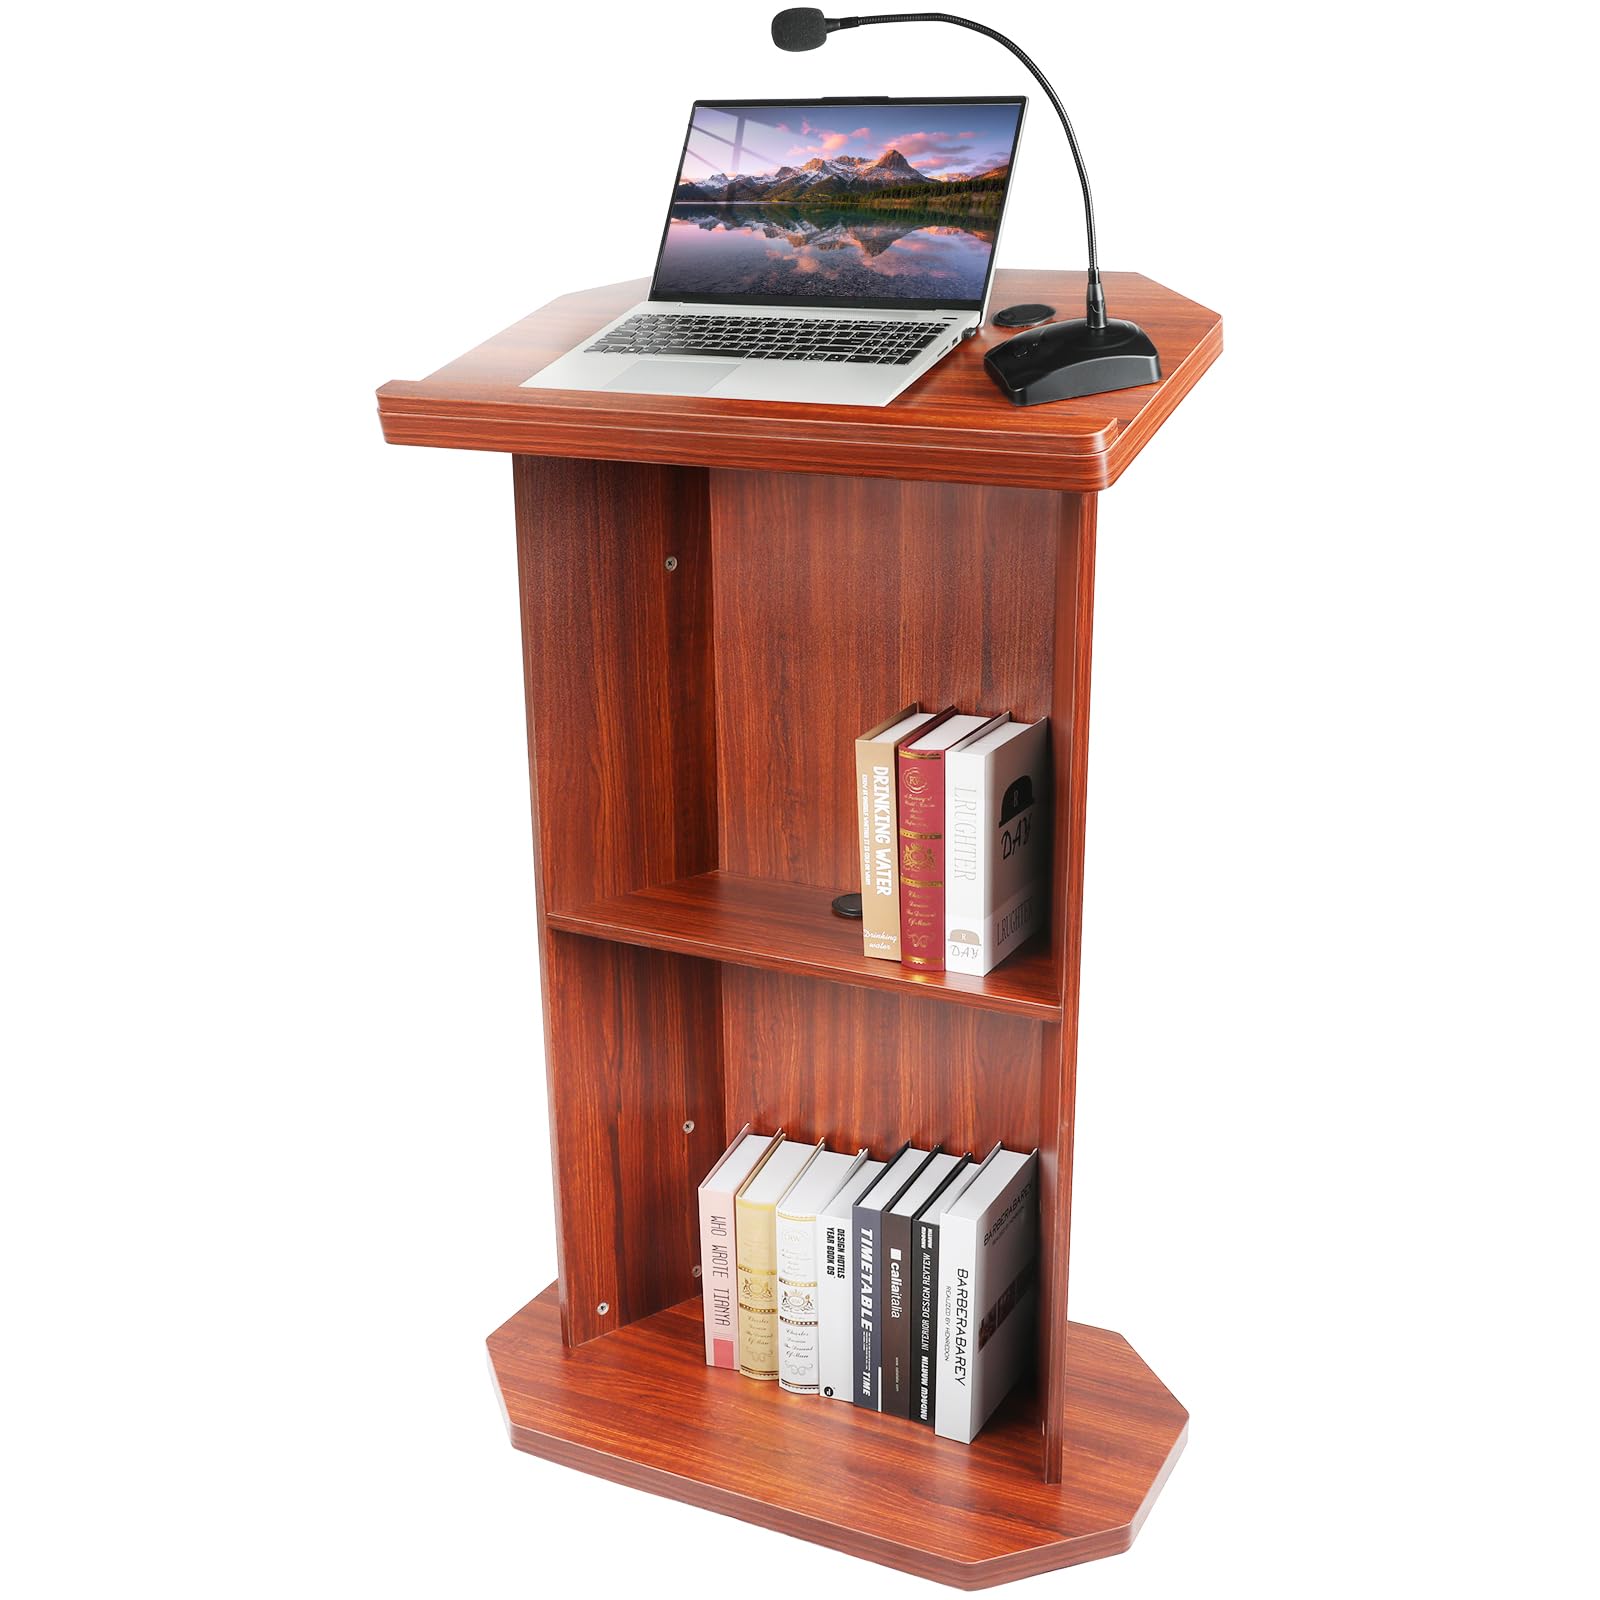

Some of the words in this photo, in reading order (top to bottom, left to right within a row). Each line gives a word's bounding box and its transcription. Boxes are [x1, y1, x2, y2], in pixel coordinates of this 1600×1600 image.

[873, 766, 891, 845] DRINKING
[875, 847, 892, 896] WATER
[862, 928, 897, 944] Drinking
[868, 942, 891, 951] water
[961, 932, 968, 941] R
[951, 945, 980, 960] DAY
[710, 1215, 727, 1237] WHO
[826, 1227, 835, 1244] YEAR
[837, 1228, 846, 1253] DESIGN
[712, 1244, 729, 1279] WROTE
[826, 1245, 835, 1265] BOOK
[837, 1254, 846, 1280] HOTELS
[826, 1265, 835, 1276] 09
[861, 1227, 873, 1332] TIMETABLE
[890, 1262, 903, 1319] caliaitalia
[922, 1285, 931, 1319] DESIGN
[944, 1285, 952, 1317] REALIZED
[713, 1288, 731, 1327] TIANYA
[944, 1317, 951, 1326] BY
[921, 1319, 930, 1351] INTERIOR
[954, 1267, 969, 1387] BARBERABAREY
[862, 1371, 871, 1397] TIME
[920, 1355, 929, 1387] MARTIN
[920, 1386, 928, 1421] ANDREW
